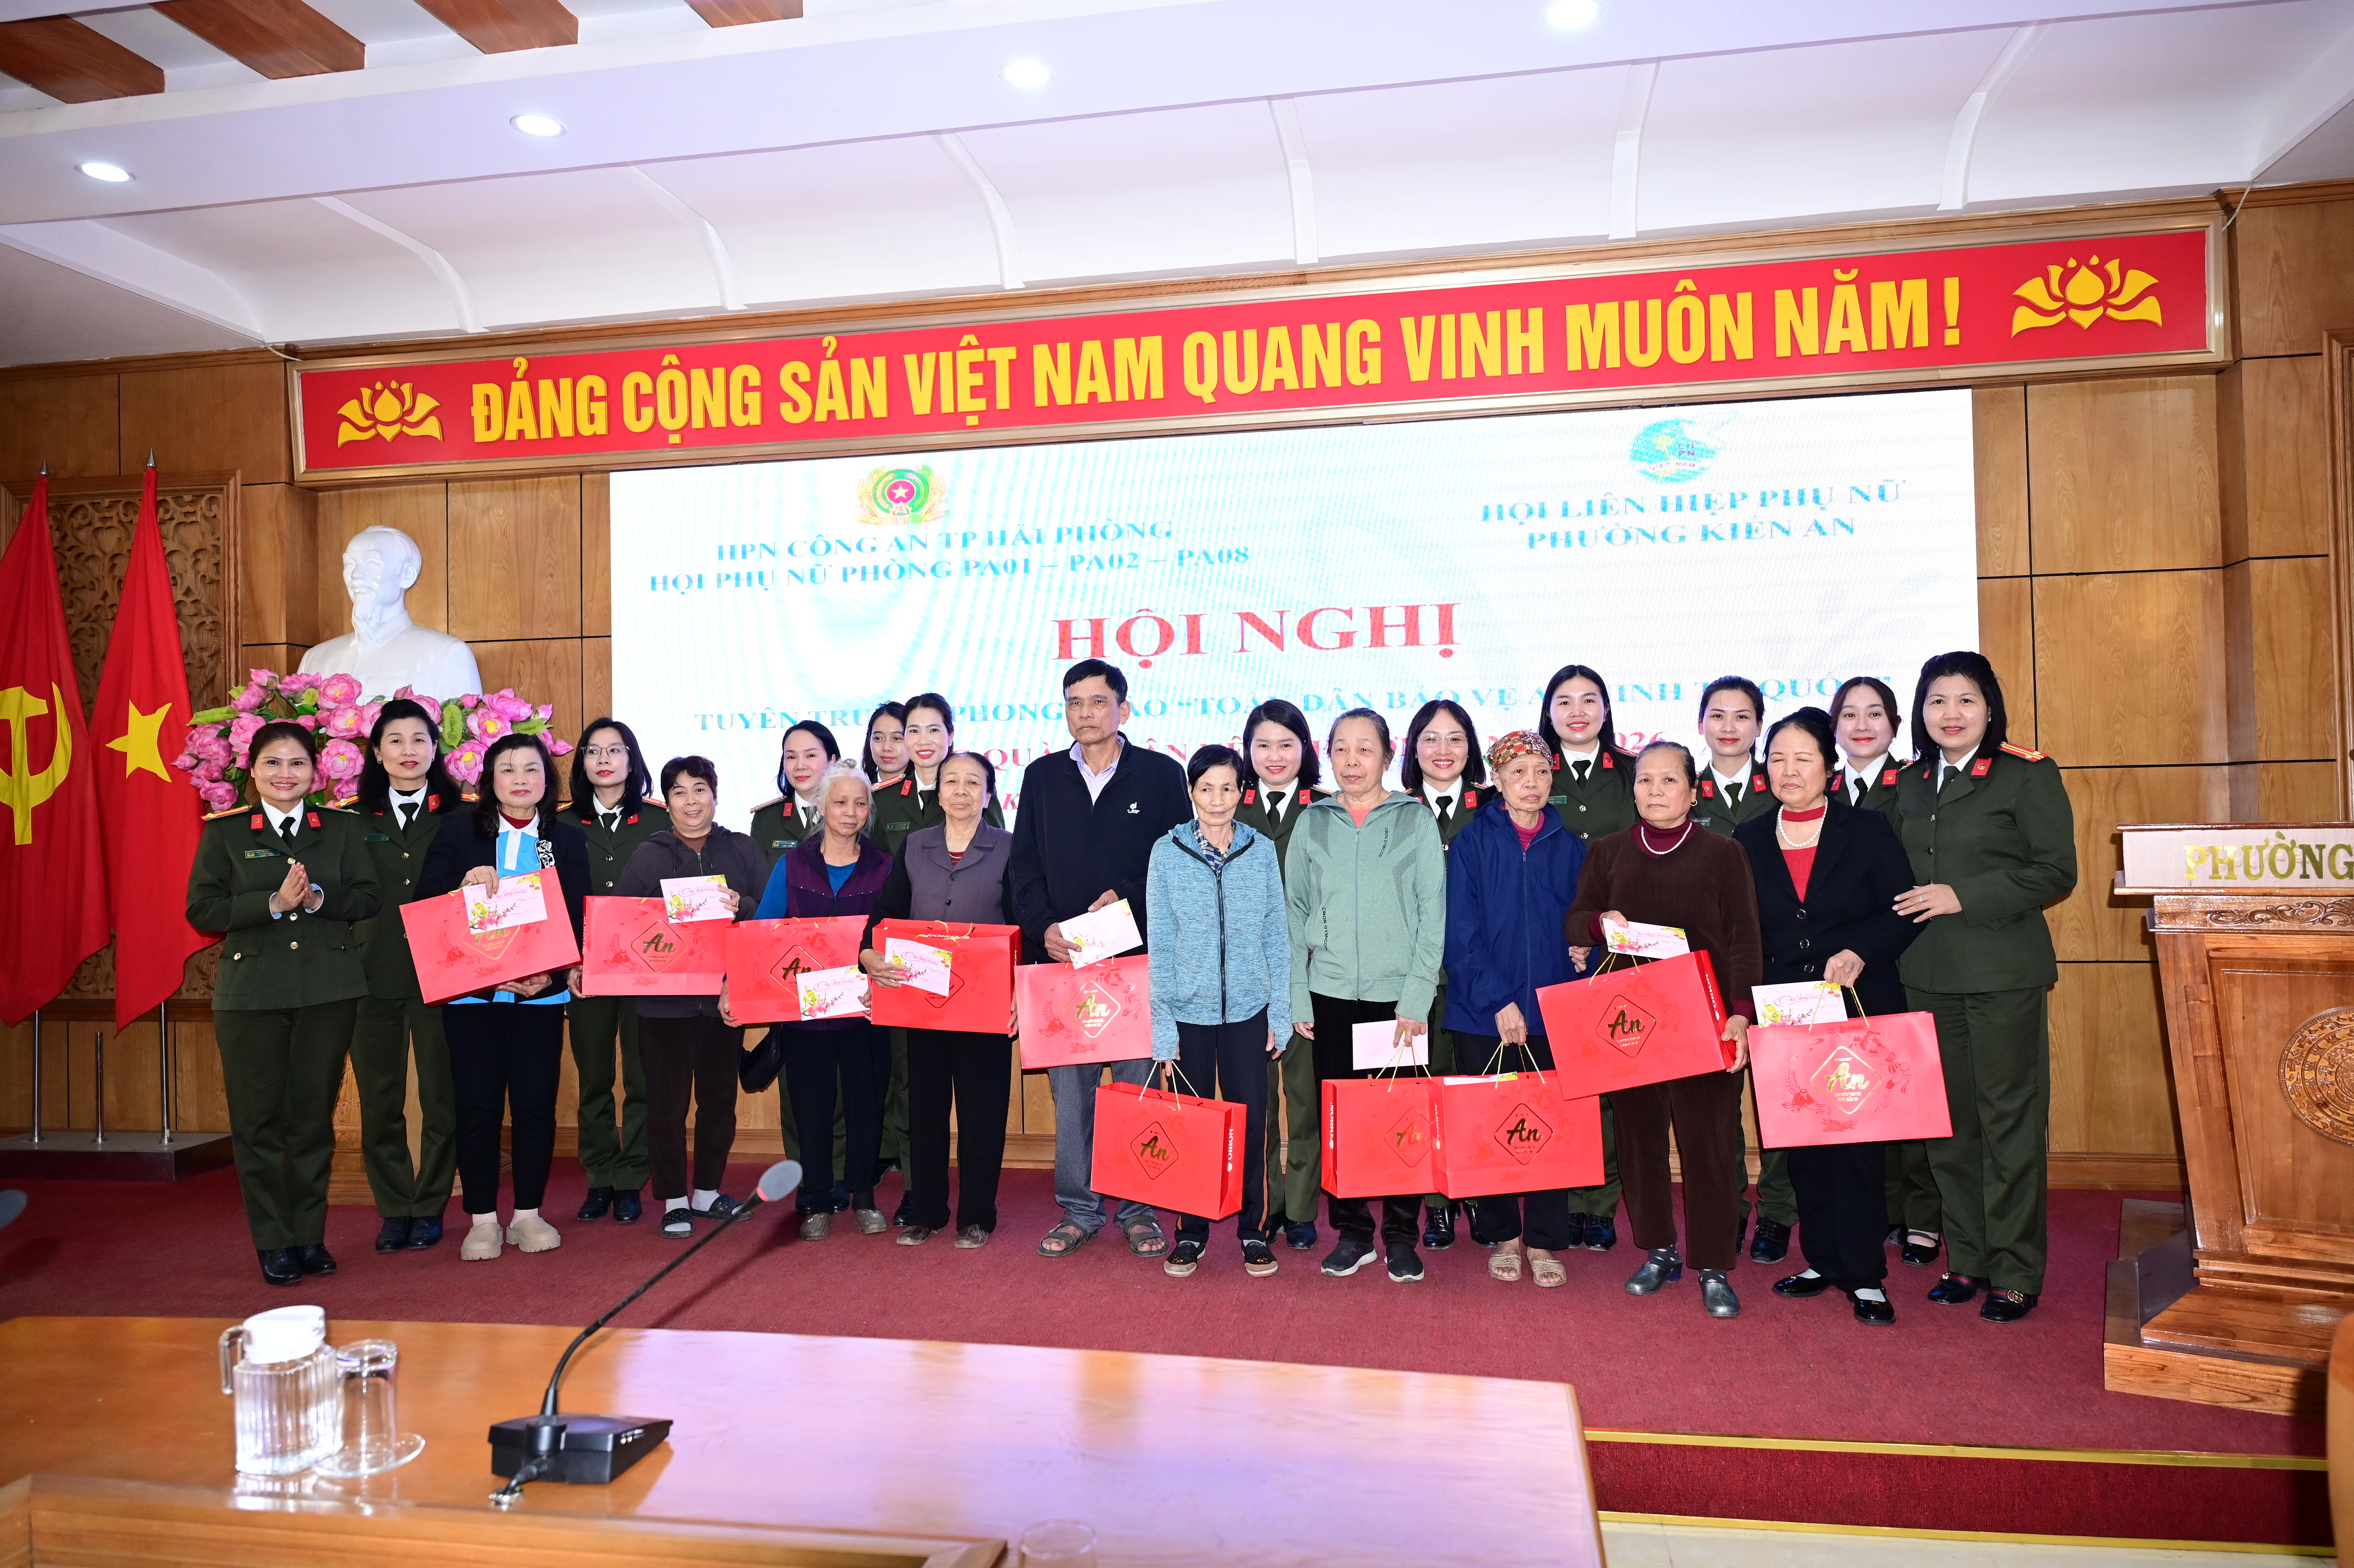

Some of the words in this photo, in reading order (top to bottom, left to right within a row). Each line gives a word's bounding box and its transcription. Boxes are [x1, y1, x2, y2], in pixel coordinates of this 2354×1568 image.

[472, 357, 607, 442] ĐẢNG
[623, 355, 761, 443] CỘNG
[780, 336, 887, 423] SẢN
[905, 335, 1017, 426] VIỆT
[1034, 336, 1164, 407] NAM
[1184, 323, 1382, 403] QUANG
[1401, 308, 1544, 382] VINH
[1566, 279, 1754, 371] MUÔN
[1775, 269, 1929, 357] NĂM
[1561, 491, 1645, 518] LIÊN
[1759, 485, 1835, 511] PHỤ
[1848, 478, 1906, 504] NỮ
[717, 543, 776, 560] HPN
[787, 534, 877, 557] CÔNG
[886, 534, 928, 553] AN
[938, 531, 978, 550] TP
[1055, 519, 1173, 544] PHÒNG
[1526, 521, 1686, 550] PHƯỜNG
[1802, 517, 1855, 539] AN
[715, 570, 774, 592] PHỤ
[786, 564, 833, 585] NỮ
[841, 558, 952, 583] PHÒNG
[963, 557, 1030, 577] PA01
[1069, 552, 1140, 572] PA02
[1176, 546, 1250, 567] PA08
[1051, 608, 1209, 670] HỘI
[1232, 603, 1462, 659] NGHỊ
[695, 707, 798, 730] TUYÊN
[951, 702, 1063, 722] PHONG
[1177, 690, 1289, 715] “TOÀ
[1302, 687, 1372, 712] DÂN
[1471, 685, 1518, 711] VỆ
[1378, 840, 1388, 858] GYMICON
[2182, 831, 2354, 880] PHƯỜNG
[643, 932, 677, 954] An
[1075, 994, 1111, 1019] An
[1705, 973, 1717, 1009] ORION
[1606, 1009, 1646, 1039] An
[1824, 1062, 1870, 1093] An
[1140, 1135, 1170, 1161] An
[1396, 1121, 1431, 1148] An
[1506, 1118, 1543, 1145] An
